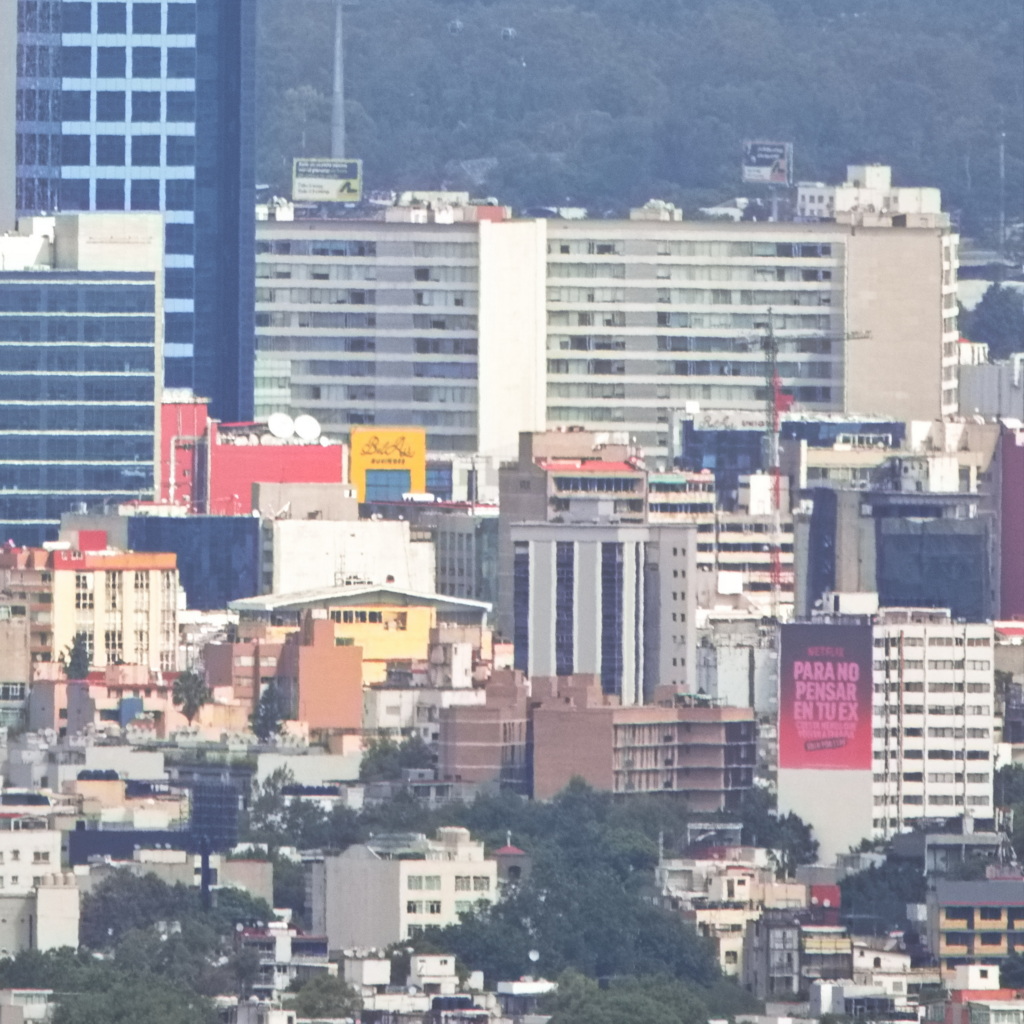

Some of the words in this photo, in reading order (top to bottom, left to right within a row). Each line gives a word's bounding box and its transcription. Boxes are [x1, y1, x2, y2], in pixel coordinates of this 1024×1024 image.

[807, 646, 844, 658] NETFLIX
[793, 661, 835, 680] PARA
[837, 662, 860, 682] NO
[795, 681, 857, 701] PENSAR
[793, 701, 814, 720] EN
[816, 702, 836, 721] TU
[838, 702, 859, 721] EX
